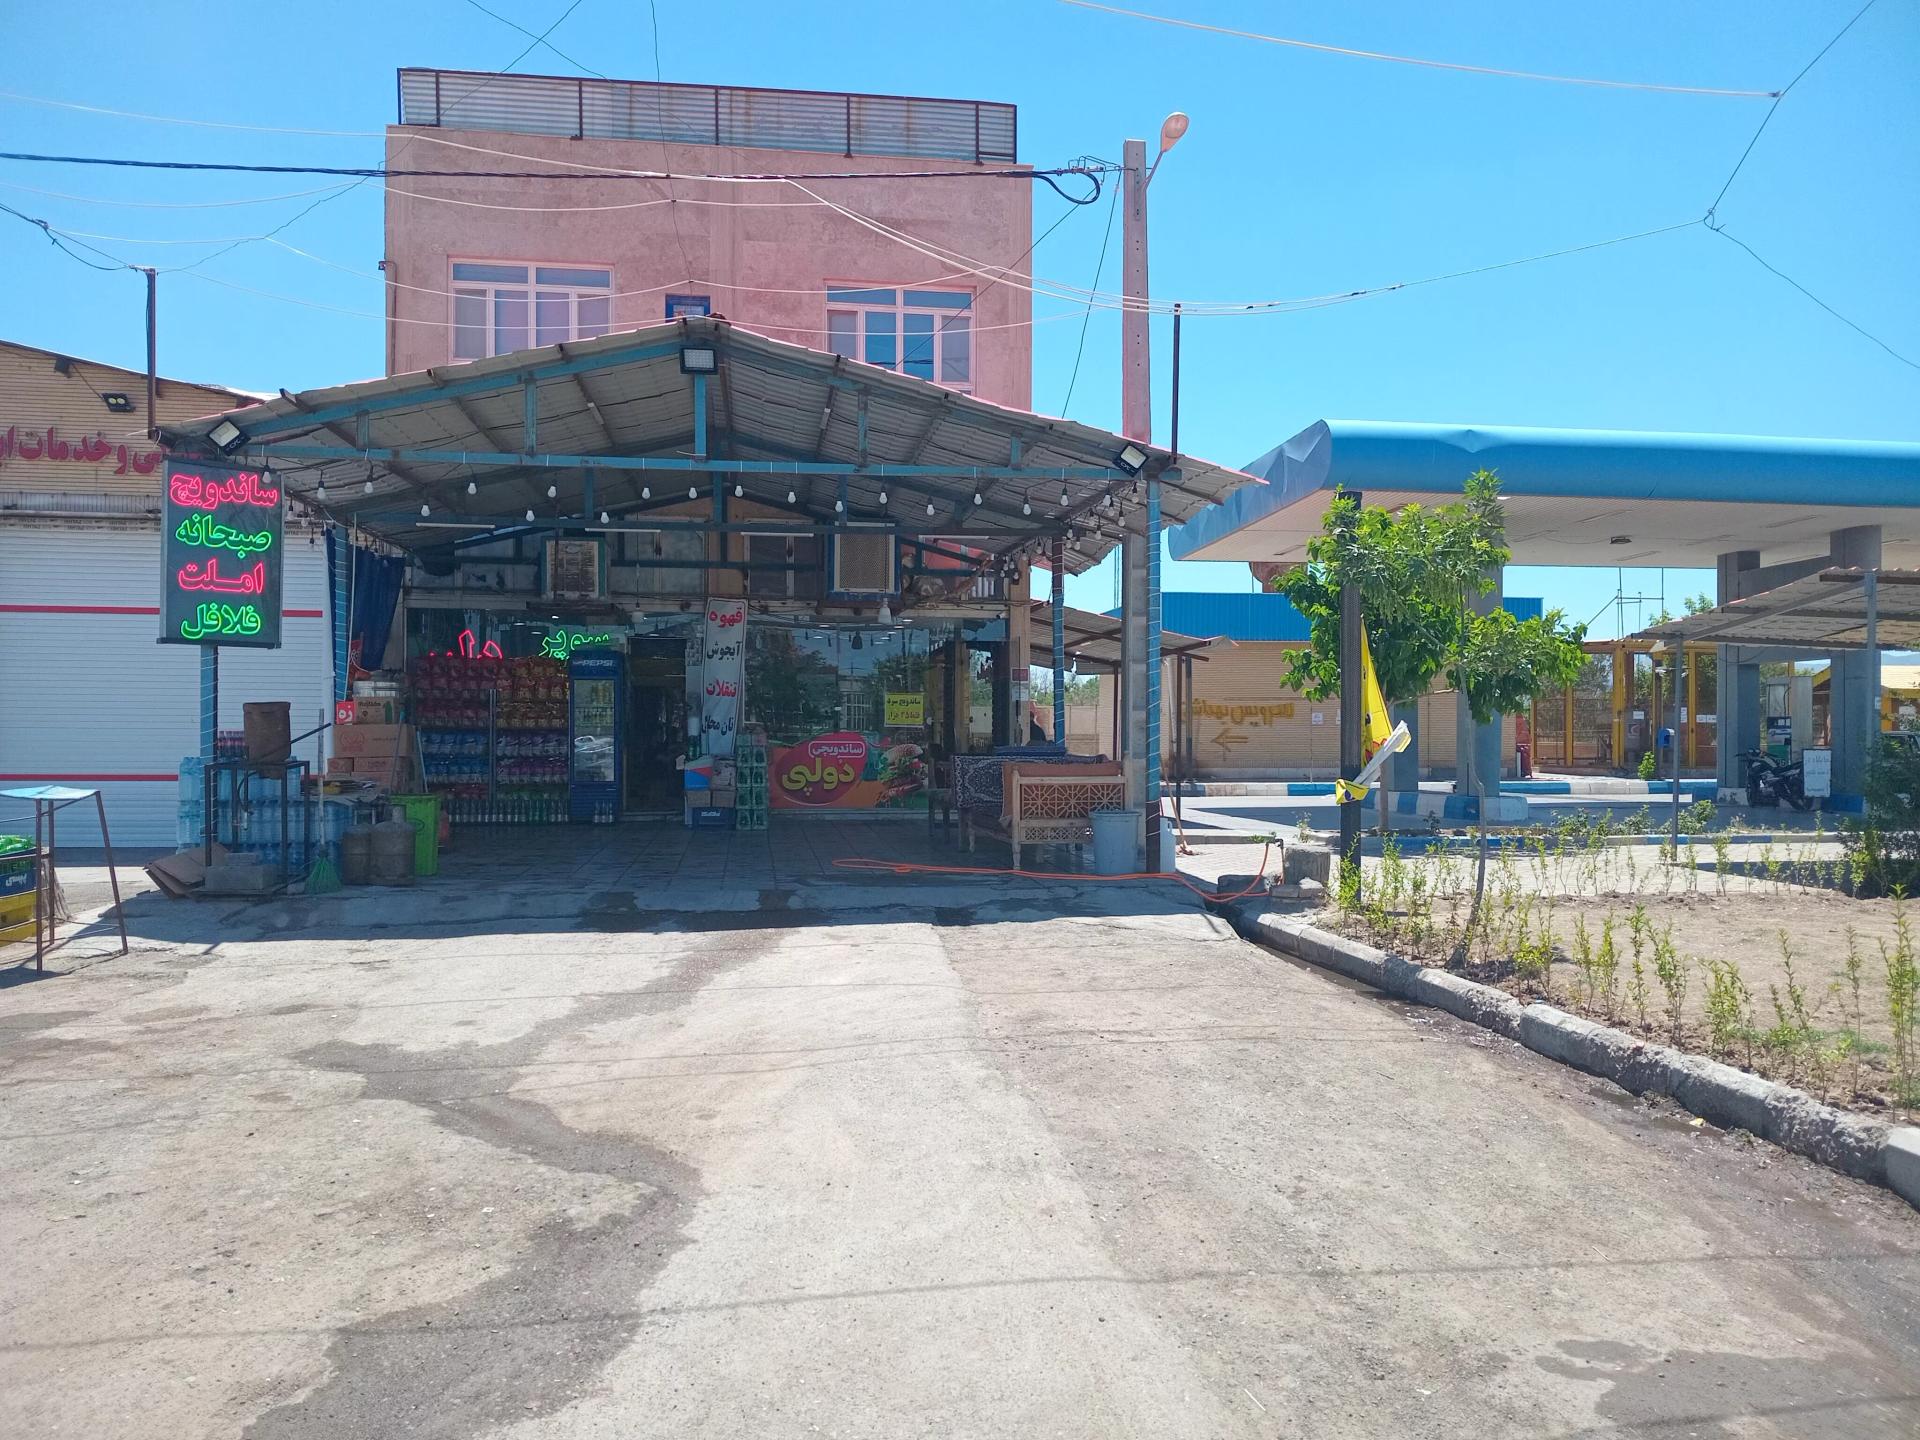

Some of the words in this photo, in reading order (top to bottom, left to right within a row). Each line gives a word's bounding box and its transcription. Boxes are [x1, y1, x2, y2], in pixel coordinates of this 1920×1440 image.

[18, 426, 113, 462] خدمات
[114, 444, 128, 475] و
[170, 473, 278, 509] ساندویچ
[175, 513, 272, 559] صبحانه
[178, 558, 264, 593] املت
[180, 602, 261, 639] فلافل
[708, 607, 743, 628] قهوه
[705, 678, 738, 698] تنقلات
